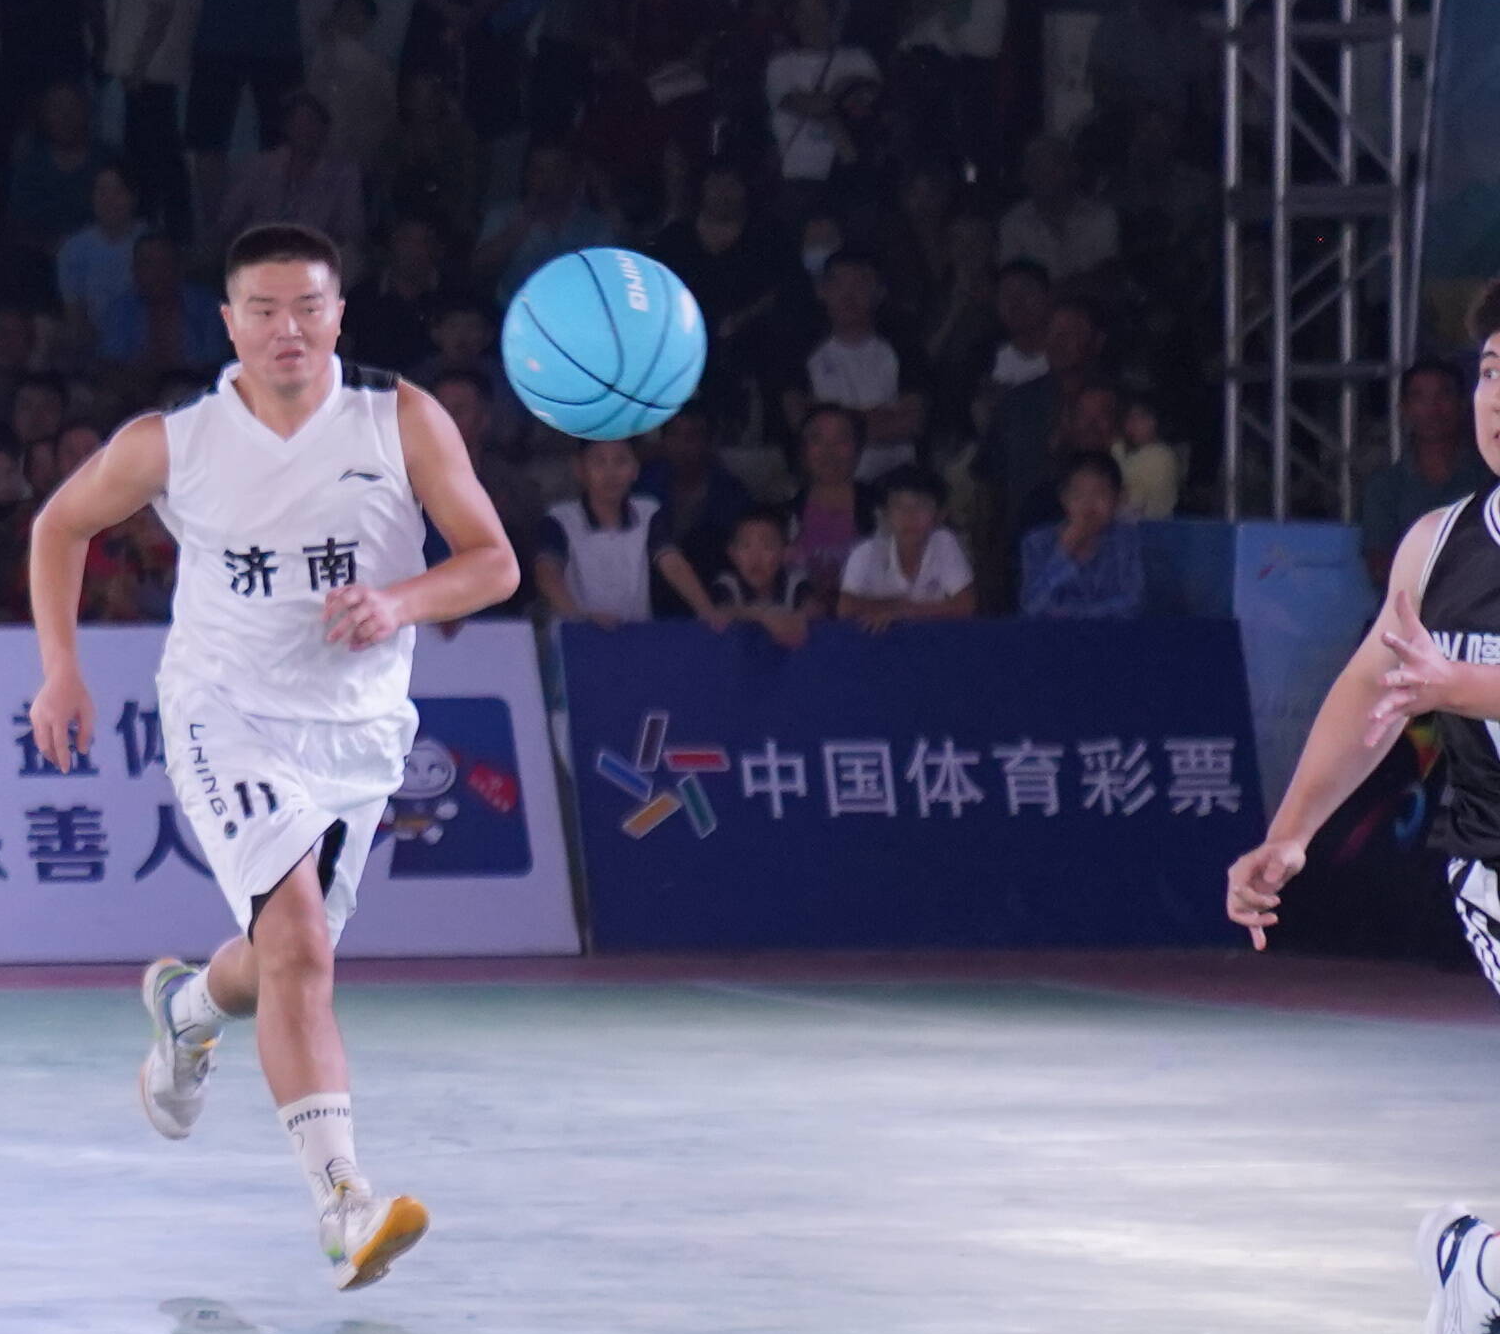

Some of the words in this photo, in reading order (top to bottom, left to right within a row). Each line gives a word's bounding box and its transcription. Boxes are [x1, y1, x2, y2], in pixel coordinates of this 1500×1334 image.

[222, 535, 360, 599] 济南
[188, 723, 229, 817] LNING
[233, 780, 279, 820] 11
[739, 735, 1242, 821] 中国体育彩票
